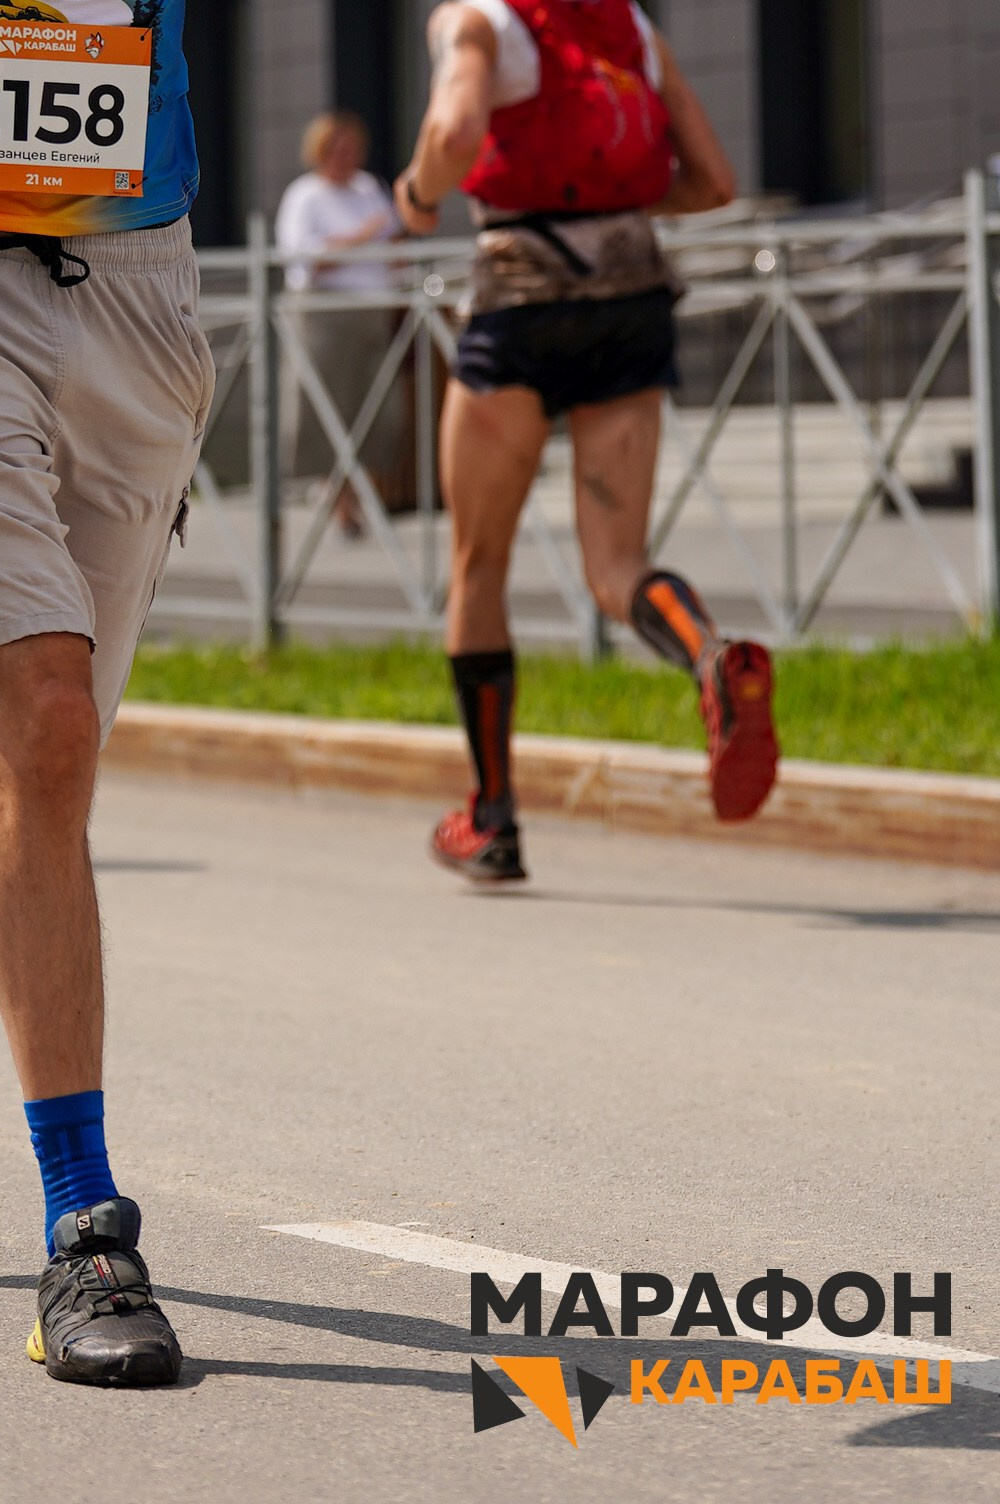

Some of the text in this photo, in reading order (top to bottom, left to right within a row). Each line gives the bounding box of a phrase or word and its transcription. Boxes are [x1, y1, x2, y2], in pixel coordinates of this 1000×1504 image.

[23, 41, 77, 52] КАРАБАШ
[51, 151, 101, 164] Евгений
[25, 174, 40, 186] 21
